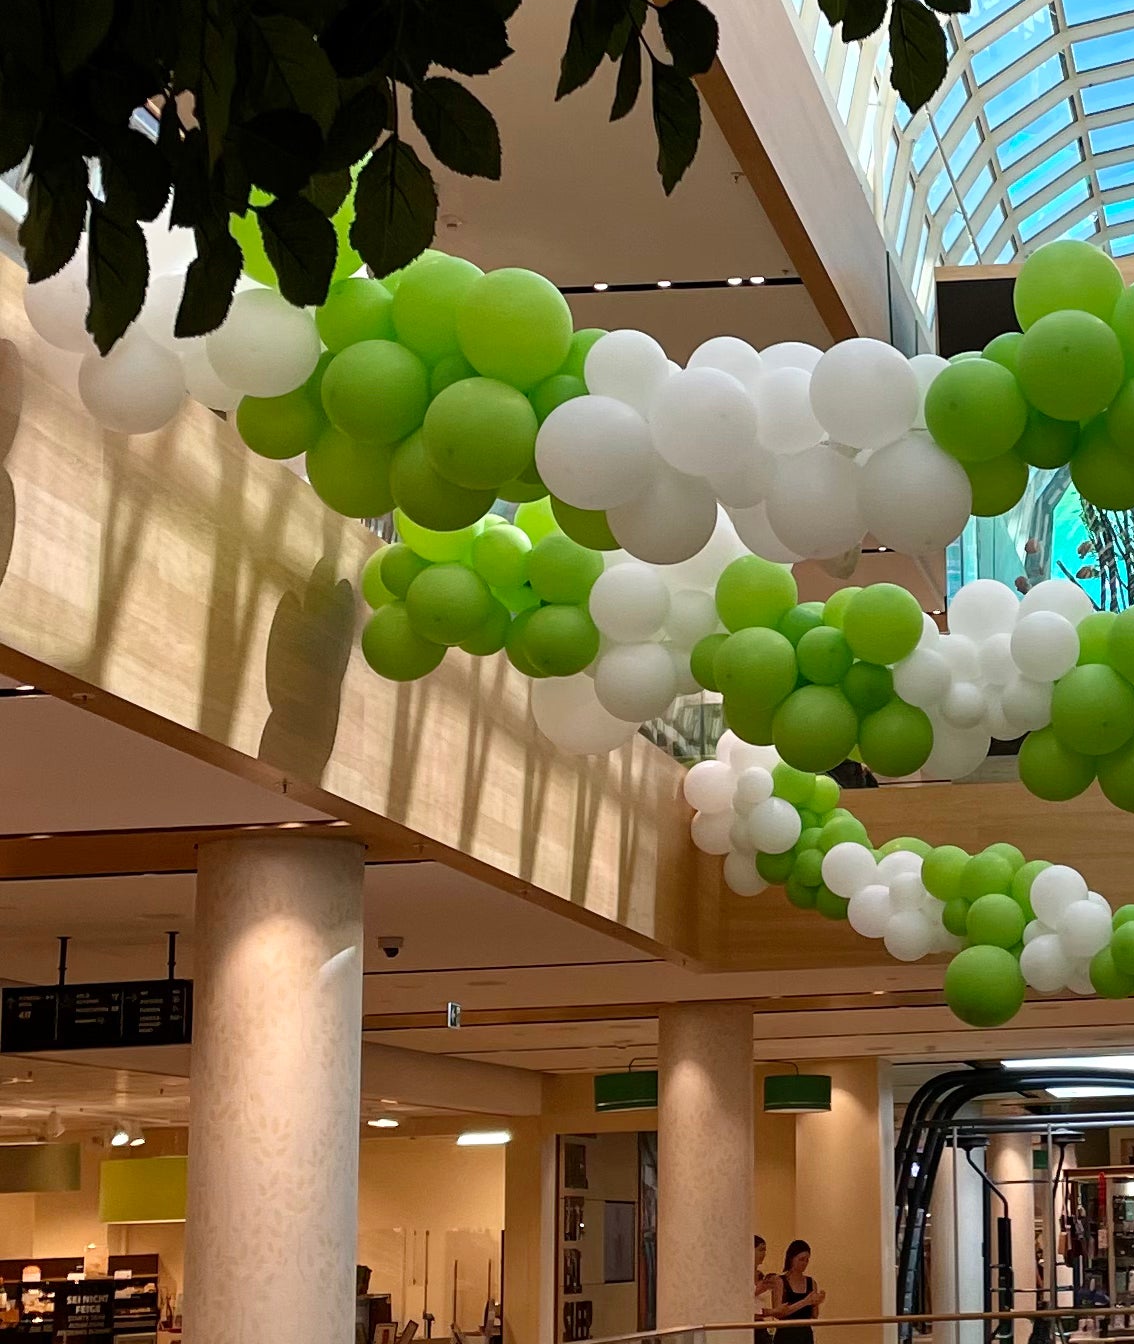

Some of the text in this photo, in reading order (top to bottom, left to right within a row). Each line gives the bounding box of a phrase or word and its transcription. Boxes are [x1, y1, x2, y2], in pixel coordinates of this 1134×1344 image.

[66, 1294, 109, 1305] SEI NICHT
[75, 1304, 101, 1314] FEIGE
